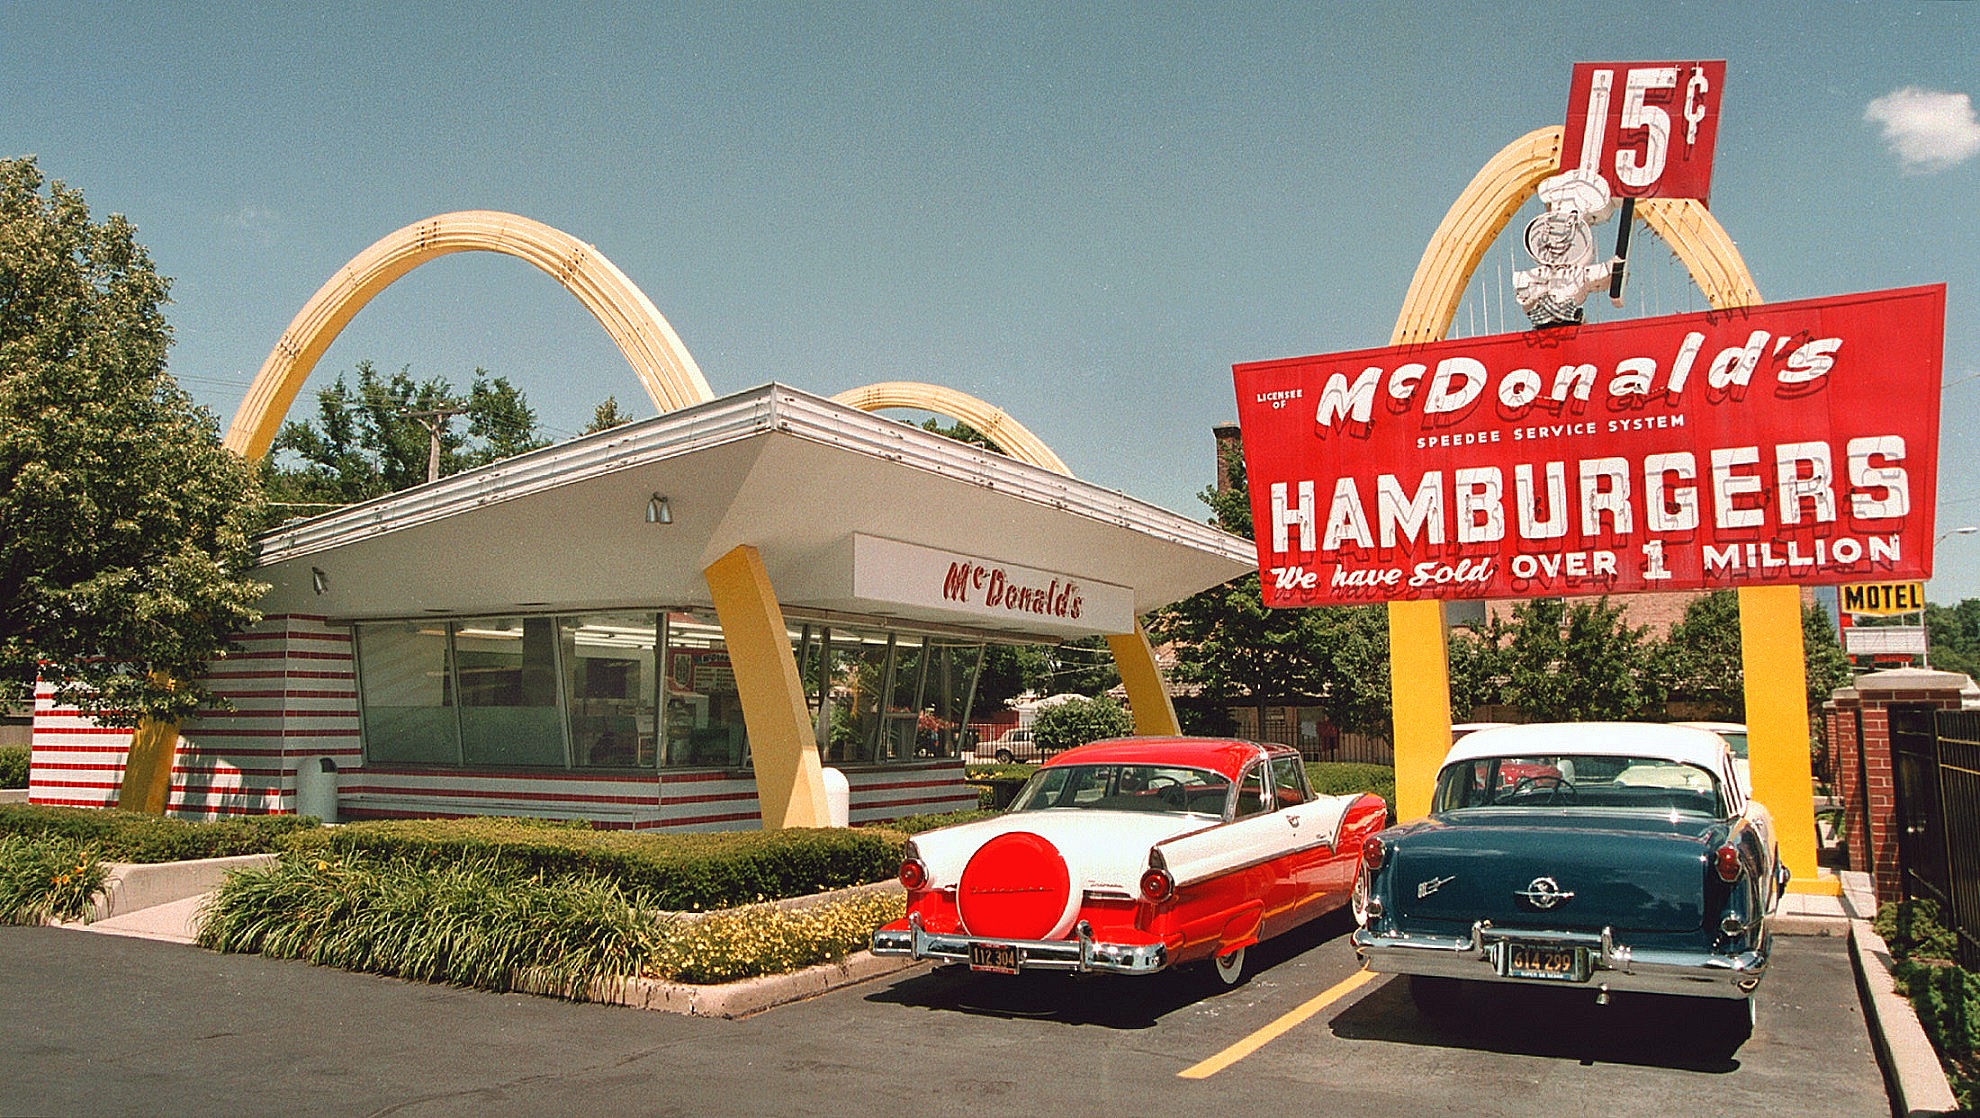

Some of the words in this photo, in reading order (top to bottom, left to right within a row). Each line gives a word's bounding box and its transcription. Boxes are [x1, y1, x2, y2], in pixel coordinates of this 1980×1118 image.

[1315, 330, 1843, 427] McDonald's
[1256, 388, 1303, 403] LICENSEE
[1272, 401, 1286, 409] OF
[1416, 430, 1501, 449] SPEEDEE
[1513, 422, 1597, 441] SERVICE
[1608, 413, 1686, 433] SYSTEM
[1269, 434, 1912, 553] HAMBURGERS
[1270, 565, 1317, 590] We
[1331, 563, 1402, 588] have
[1511, 550, 1618, 579] OVER
[1641, 539, 1673, 581] 1
[1702, 534, 1901, 572] MILLION
[1844, 584, 1921, 611] MOTEL
[995, 949, 1015, 967] 304
[1514, 950, 1541, 970] 614
[1545, 953, 1571, 972] 299
